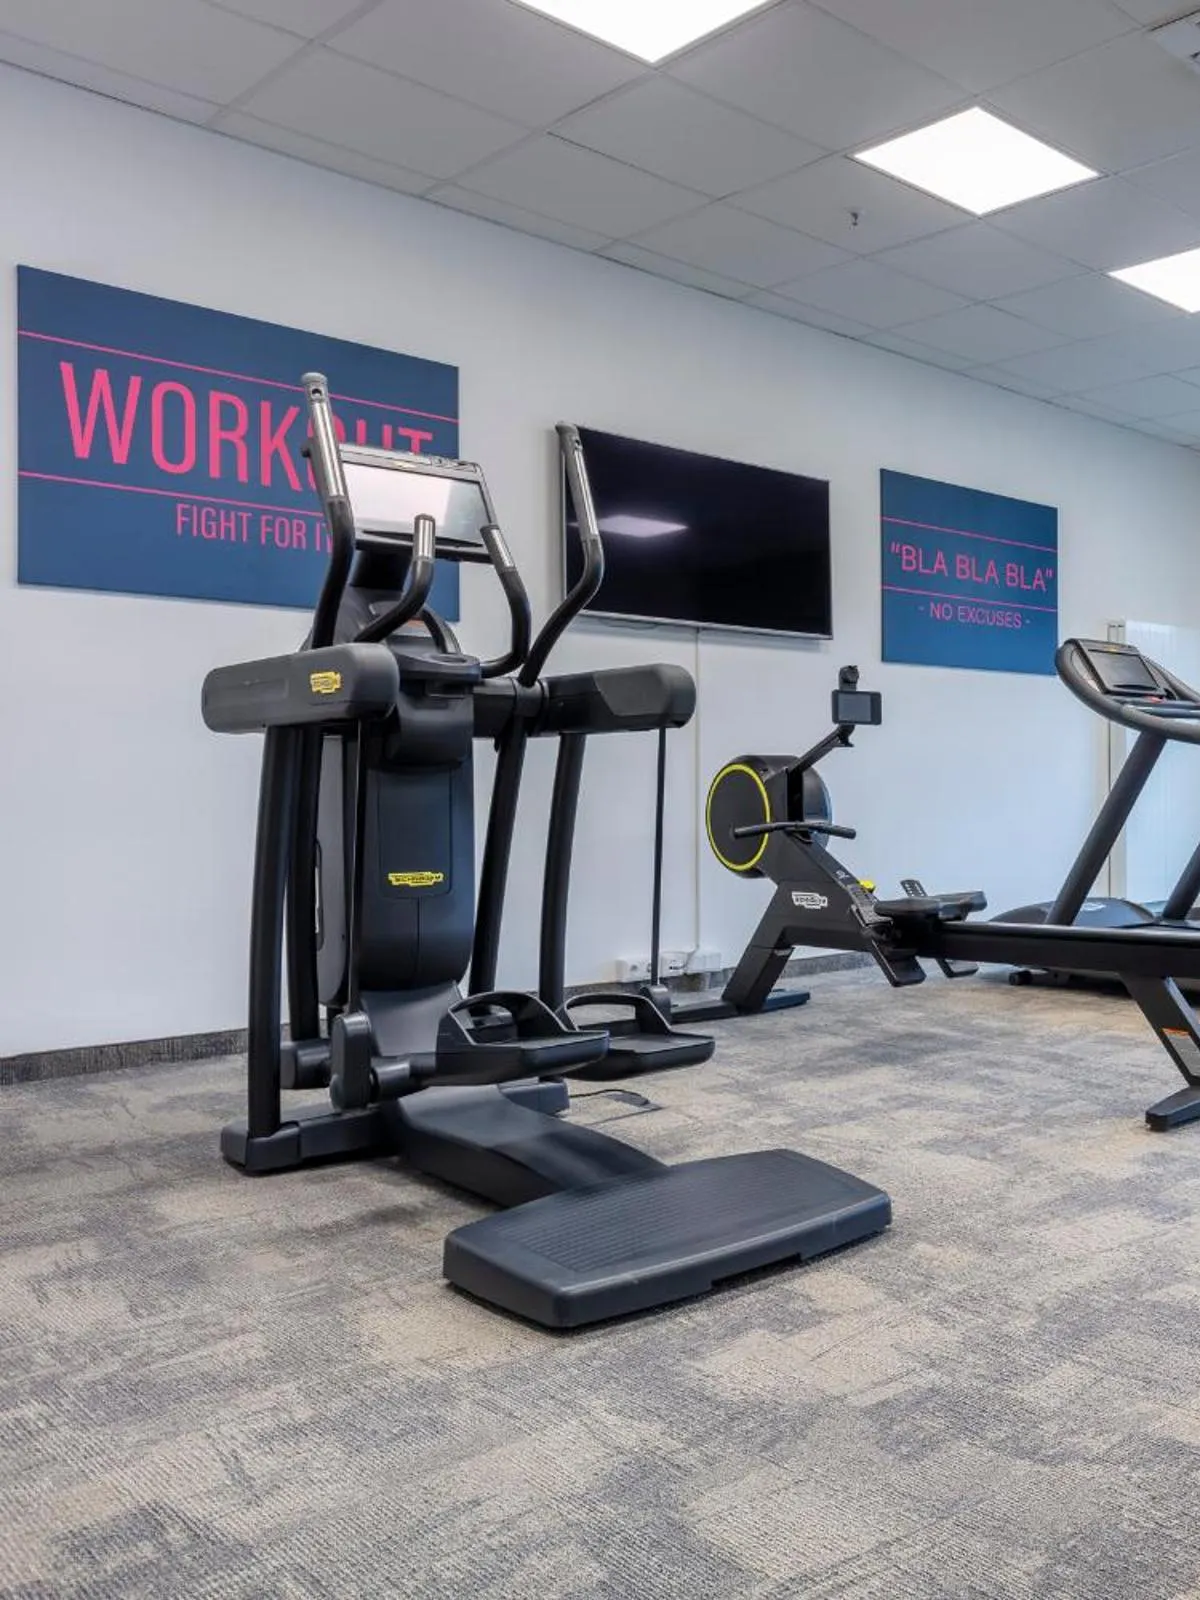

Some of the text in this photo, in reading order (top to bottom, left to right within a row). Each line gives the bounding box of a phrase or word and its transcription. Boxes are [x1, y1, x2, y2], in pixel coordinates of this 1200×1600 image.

[59, 360, 433, 492] WORK
[176, 502, 252, 543] FIGHT
[260, 514, 307, 550] FOR
[890, 541, 1053, 592] "BLA BLA BLA"
[930, 601, 952, 620] NO
[957, 606, 1022, 628] EXCUSES
